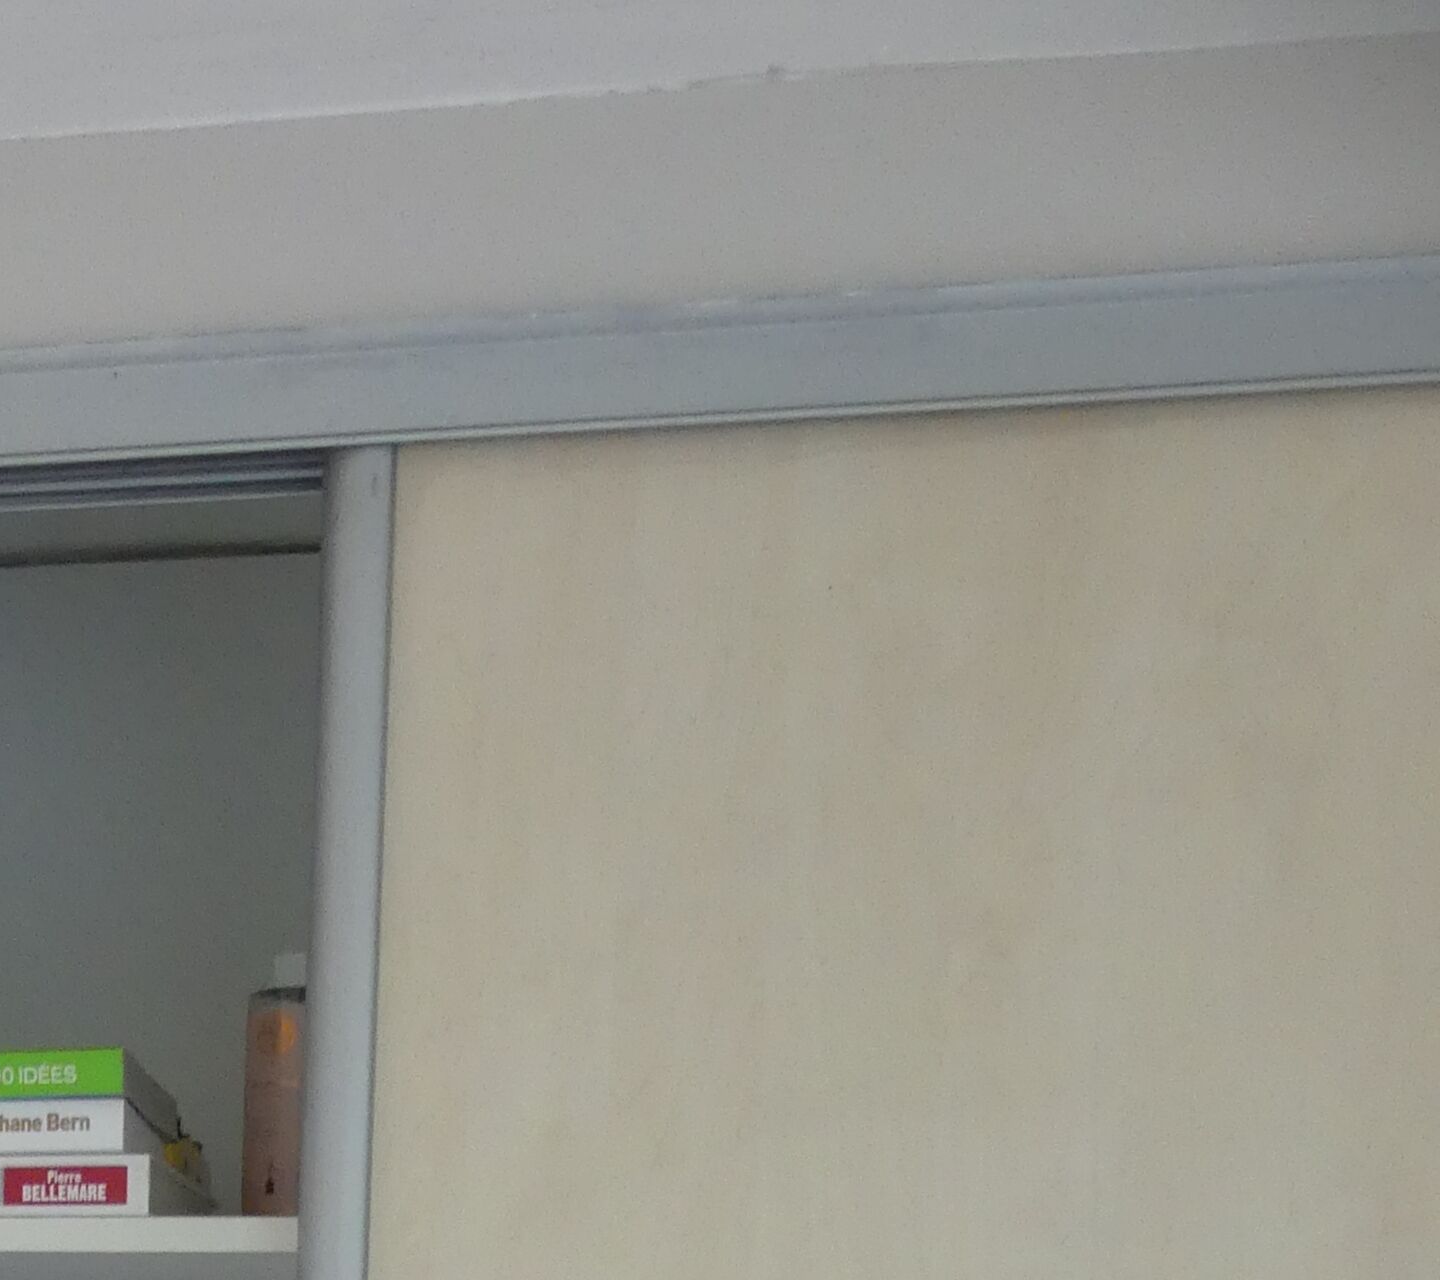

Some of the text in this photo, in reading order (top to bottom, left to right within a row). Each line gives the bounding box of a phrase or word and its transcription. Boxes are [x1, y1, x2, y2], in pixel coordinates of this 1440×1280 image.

[18, 1063, 77, 1085] IDÉES
[46, 1113, 91, 1133] Bern
[47, 1170, 82, 1184] Pierre
[21, 1184, 107, 1202] BELLEMARE
